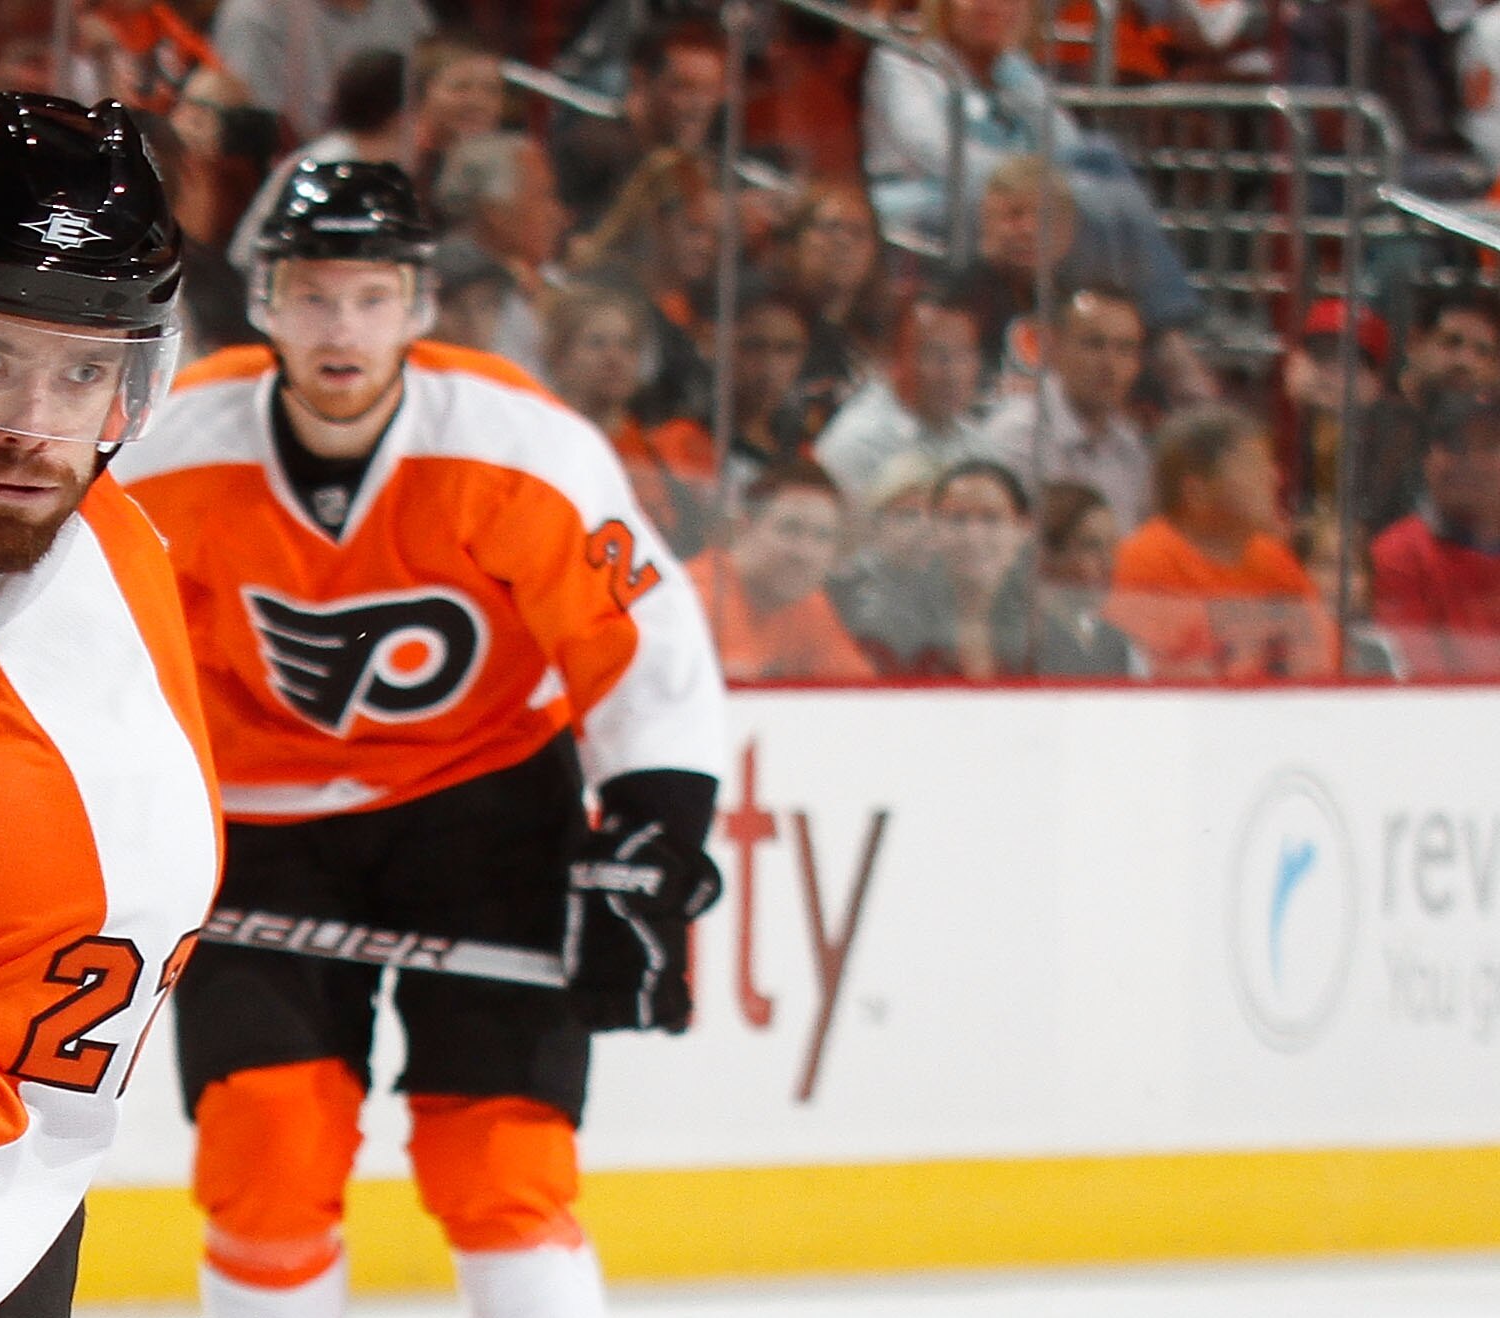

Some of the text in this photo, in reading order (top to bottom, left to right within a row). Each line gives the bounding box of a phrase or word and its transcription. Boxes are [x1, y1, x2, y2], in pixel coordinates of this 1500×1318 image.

[583, 517, 662, 614] 2
[687, 733, 892, 1108] ty
[8, 928, 201, 1099] 2
